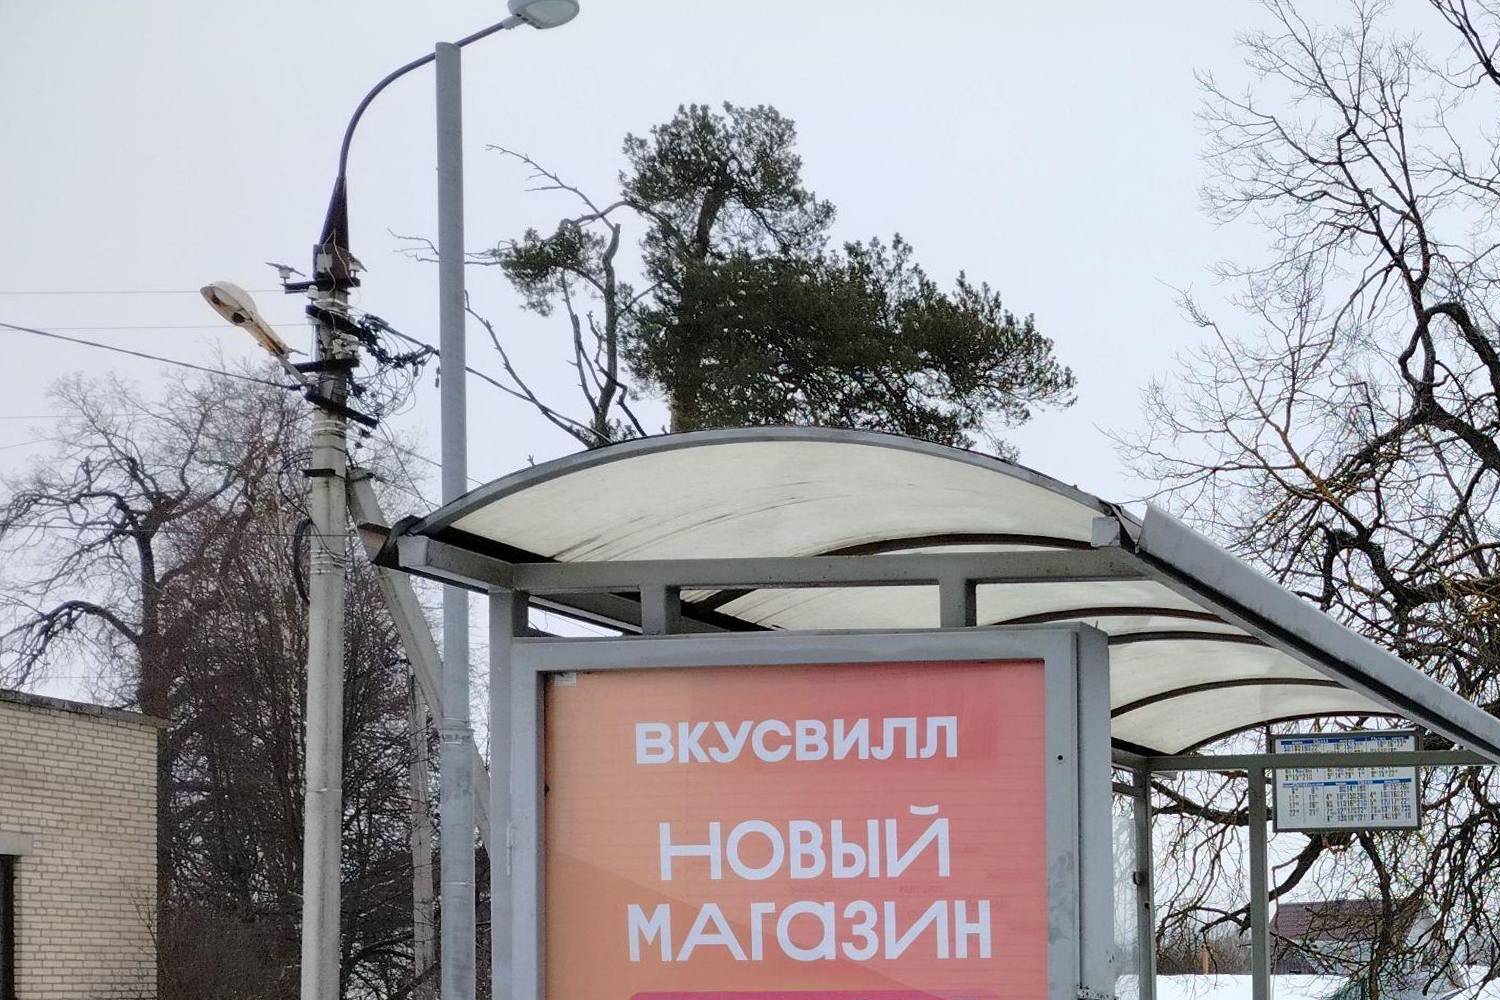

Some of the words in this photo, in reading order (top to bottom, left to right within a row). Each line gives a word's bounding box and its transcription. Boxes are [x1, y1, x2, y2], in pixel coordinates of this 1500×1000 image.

[635, 716, 959, 764] ВКУСВИЛЛ
[659, 804, 950, 881] НОВЫЙ
[627, 899, 992, 962] МАГАЗИН
